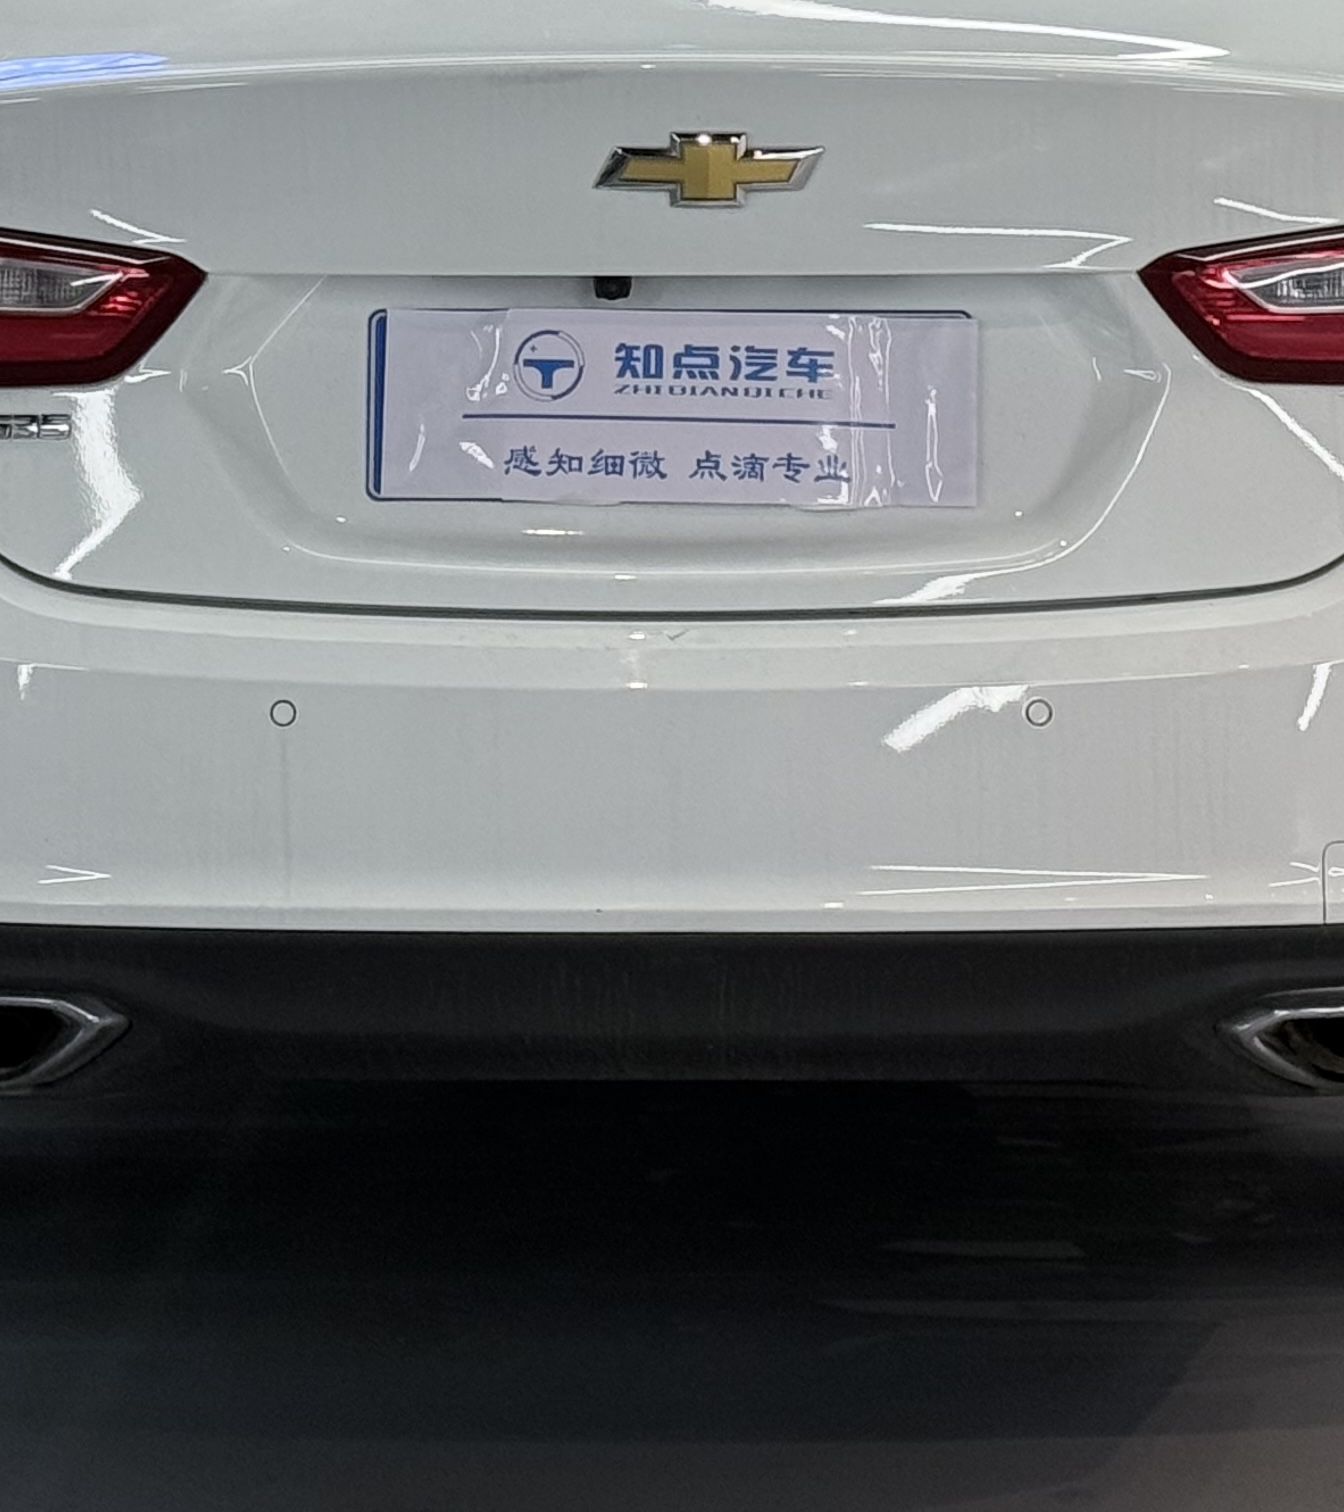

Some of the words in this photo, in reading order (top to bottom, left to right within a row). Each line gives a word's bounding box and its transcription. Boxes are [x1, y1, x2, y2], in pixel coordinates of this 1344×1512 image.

[615, 342, 836, 384] 知点汽车
[504, 446, 668, 480] 感知细微
[689, 449, 853, 484] 点滴专业
